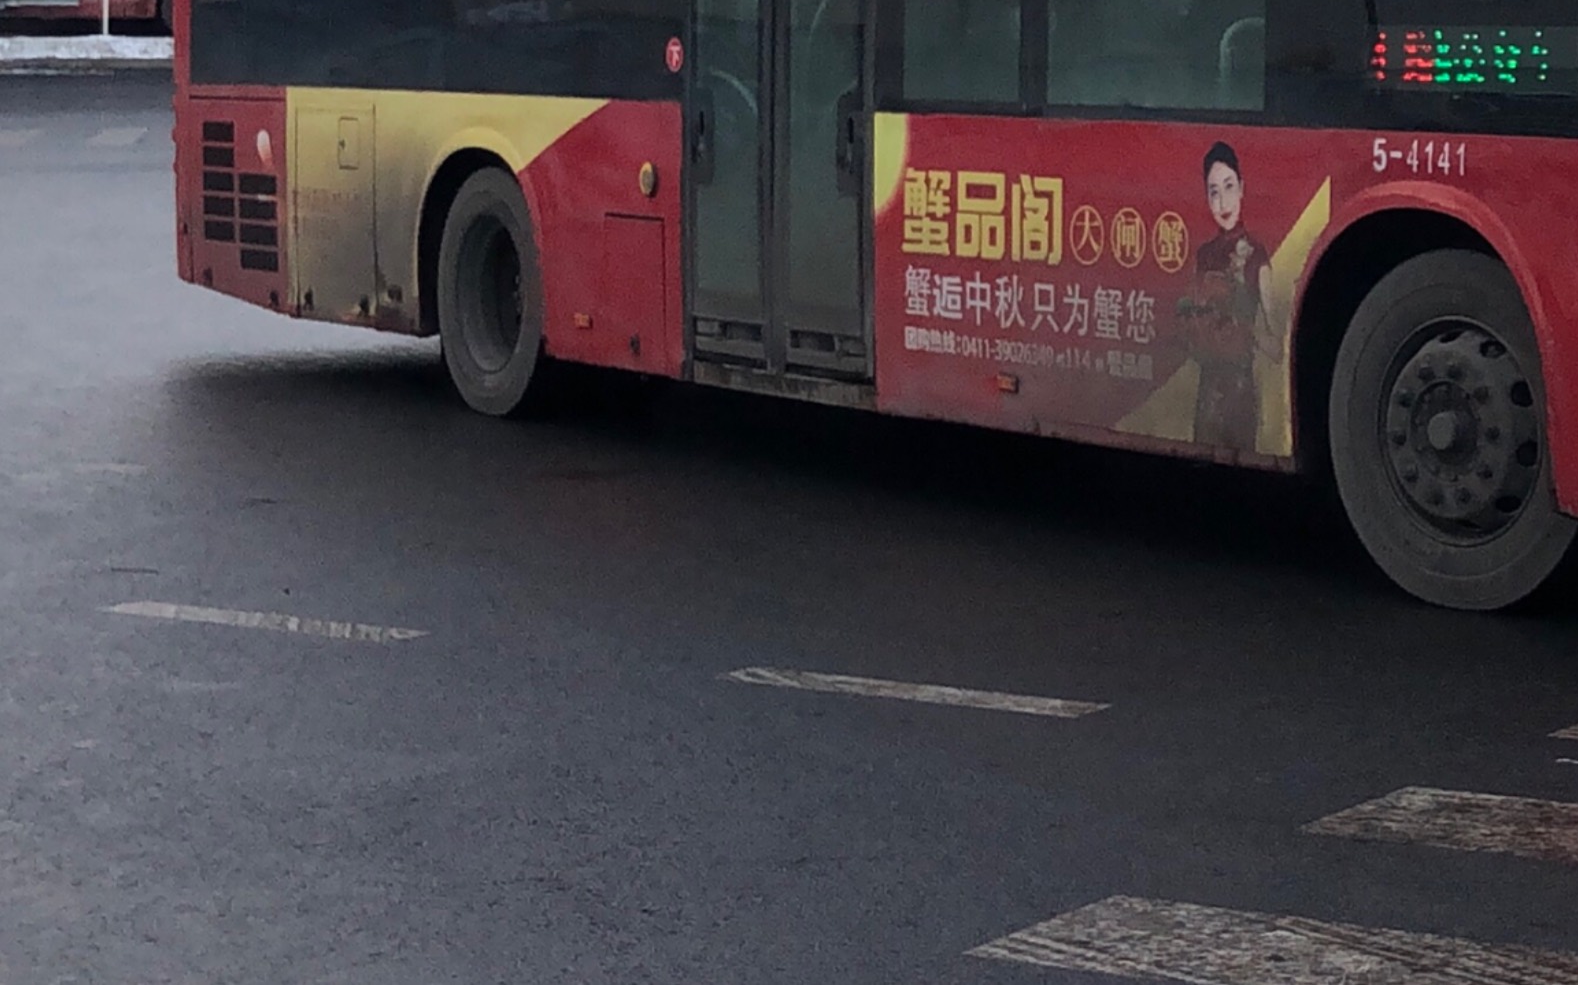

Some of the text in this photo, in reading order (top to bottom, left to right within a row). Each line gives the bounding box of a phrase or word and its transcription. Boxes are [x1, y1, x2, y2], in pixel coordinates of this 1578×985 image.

[1372, 137, 1466, 176] 5-4141
[900, 166, 1064, 266] 蟹品阁
